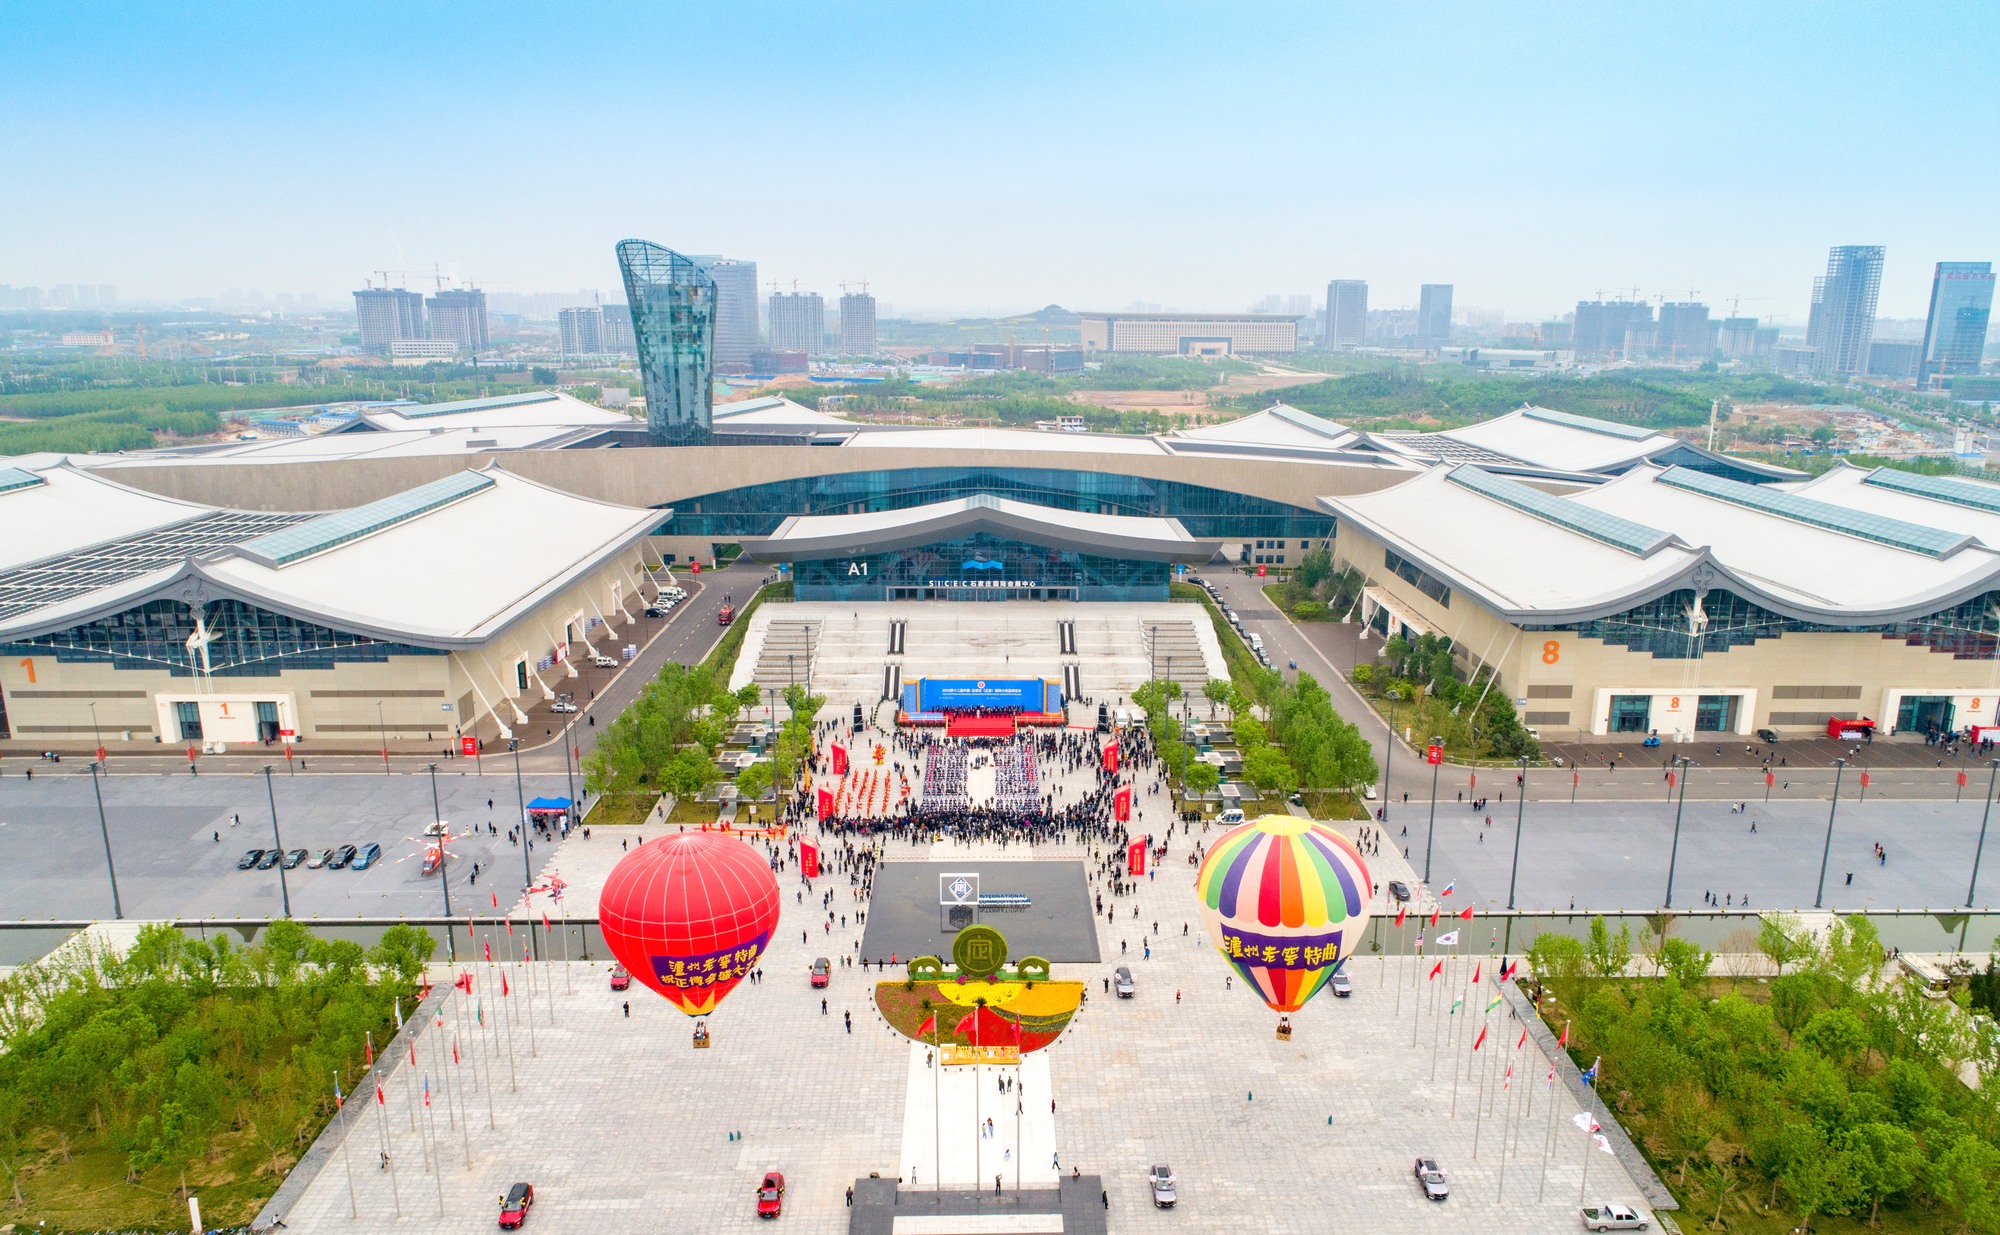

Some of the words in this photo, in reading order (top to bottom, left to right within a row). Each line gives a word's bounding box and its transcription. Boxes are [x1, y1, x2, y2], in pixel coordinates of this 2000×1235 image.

[848, 562, 868, 576] A1
[1543, 640, 1560, 664] 8
[20, 658, 36, 683] 1
[220, 702, 228, 715] 1
[1671, 696, 1680, 708] 8
[1971, 697, 1980, 708] 8
